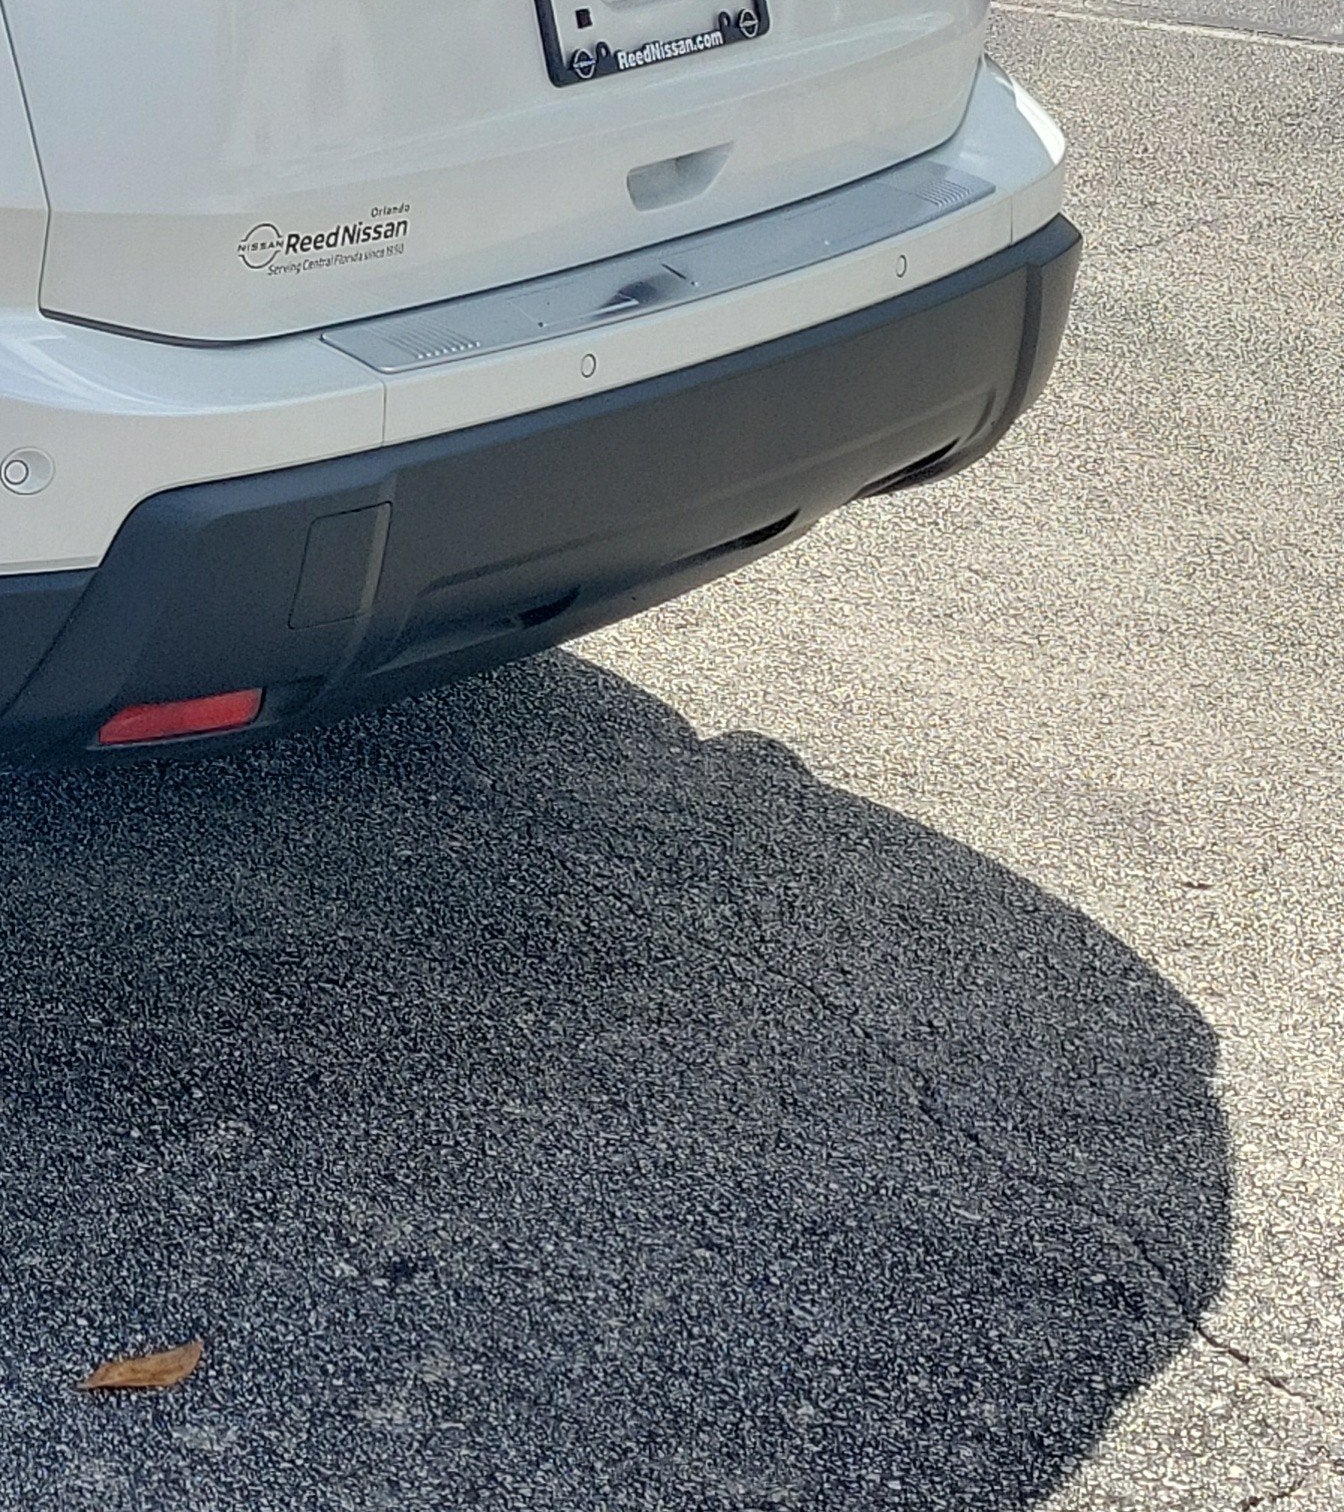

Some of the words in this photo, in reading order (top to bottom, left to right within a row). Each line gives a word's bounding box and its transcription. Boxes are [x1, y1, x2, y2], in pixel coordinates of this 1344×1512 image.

[616, 30, 724, 70] ReedNissan.com
[371, 203, 410, 218] Orlando
[237, 239, 284, 252] NISSAN
[267, 262, 301, 276] Serving
[302, 255, 333, 270] Central
